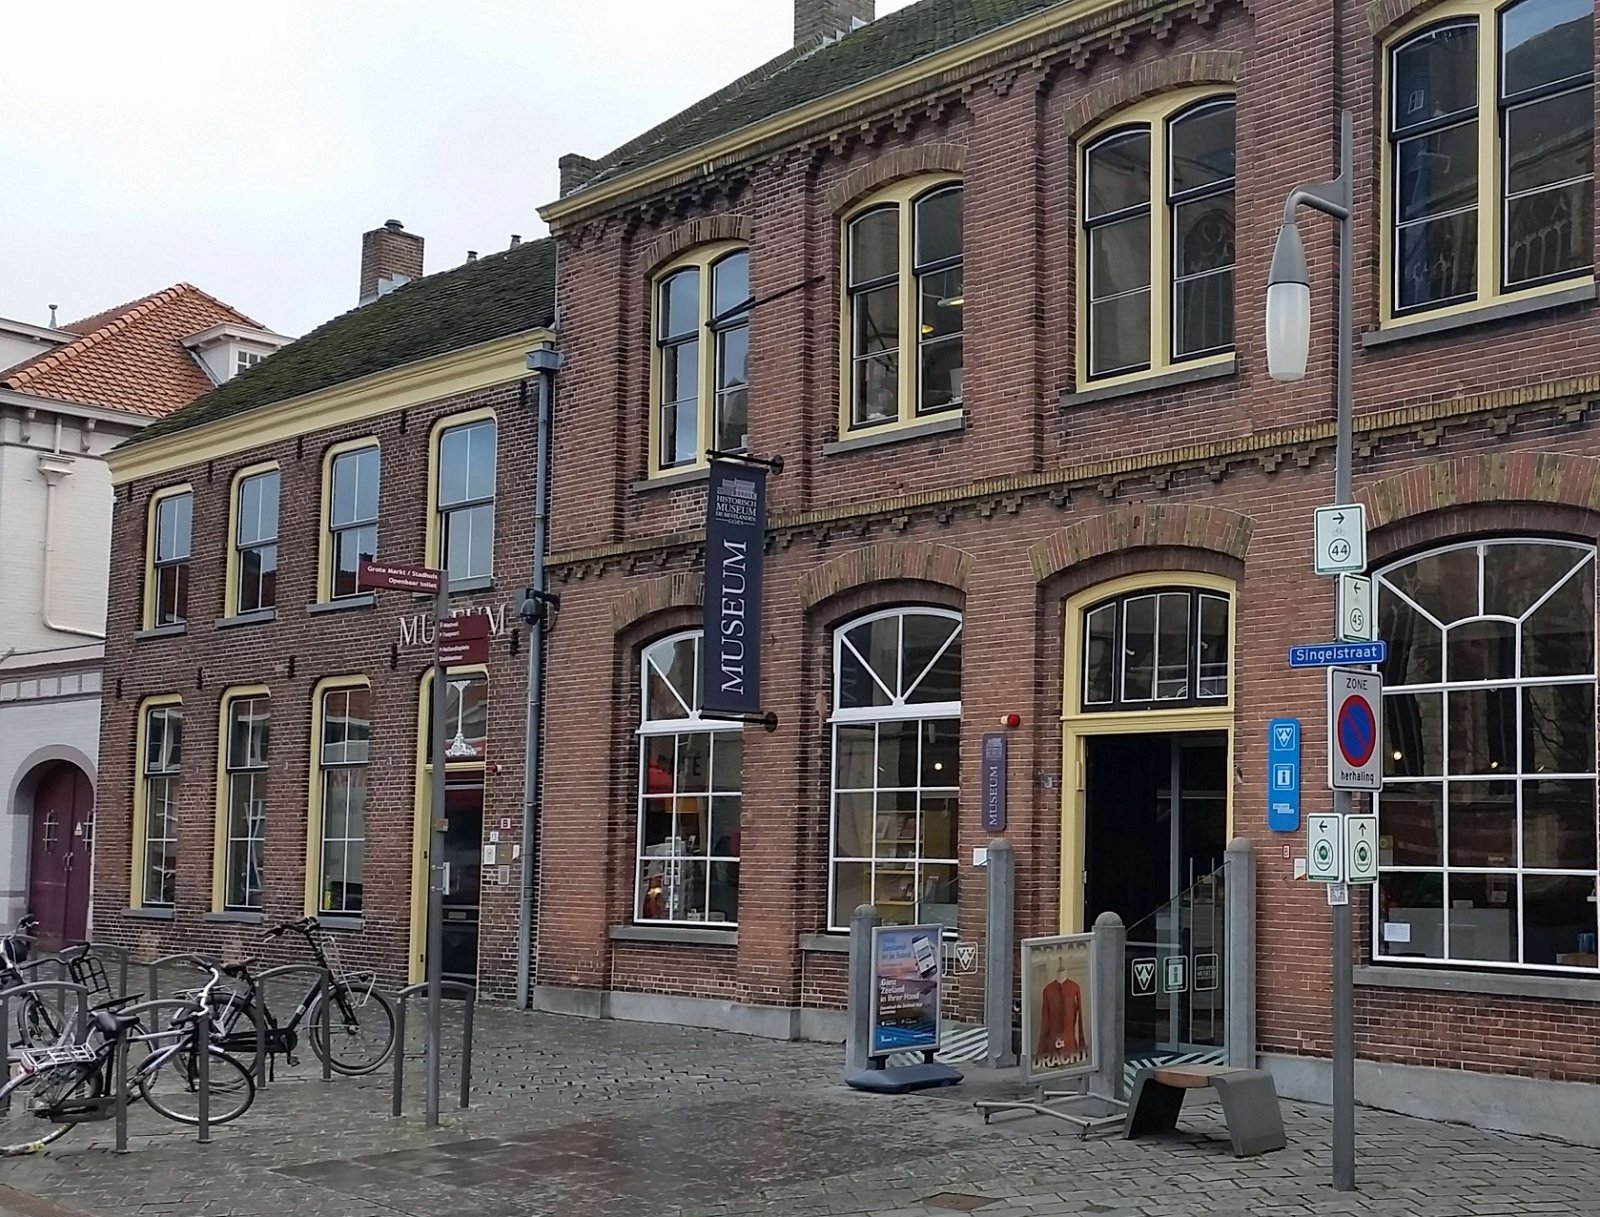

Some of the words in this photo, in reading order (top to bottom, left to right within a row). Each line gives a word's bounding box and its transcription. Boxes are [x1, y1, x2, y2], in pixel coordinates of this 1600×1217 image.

[716, 495, 757, 507] HISTORISCH
[716, 502, 757, 517] MUSEUM
[1331, 544, 1349, 556] 44
[367, 565, 386, 573] Grote
[387, 568, 406, 576] Markt
[411, 570, 438, 579] Stadhuis
[388, 577, 419, 587] Openbaar
[720, 539, 747, 695] MUSEUM
[1351, 613, 1363, 626] 45
[398, 603, 507, 646] MUM
[1296, 645, 1377, 663] Singelstraat
[1346, 678, 1368, 691] ZONE
[1340, 770, 1374, 785] herhaling
[989, 765, 998, 826] MUSEUM
[880, 984, 905, 994] Zeeland
[880, 994, 887, 1002] in
[904, 991, 920, 1001] Hand
[1032, 1050, 1088, 1070] DRACHT
